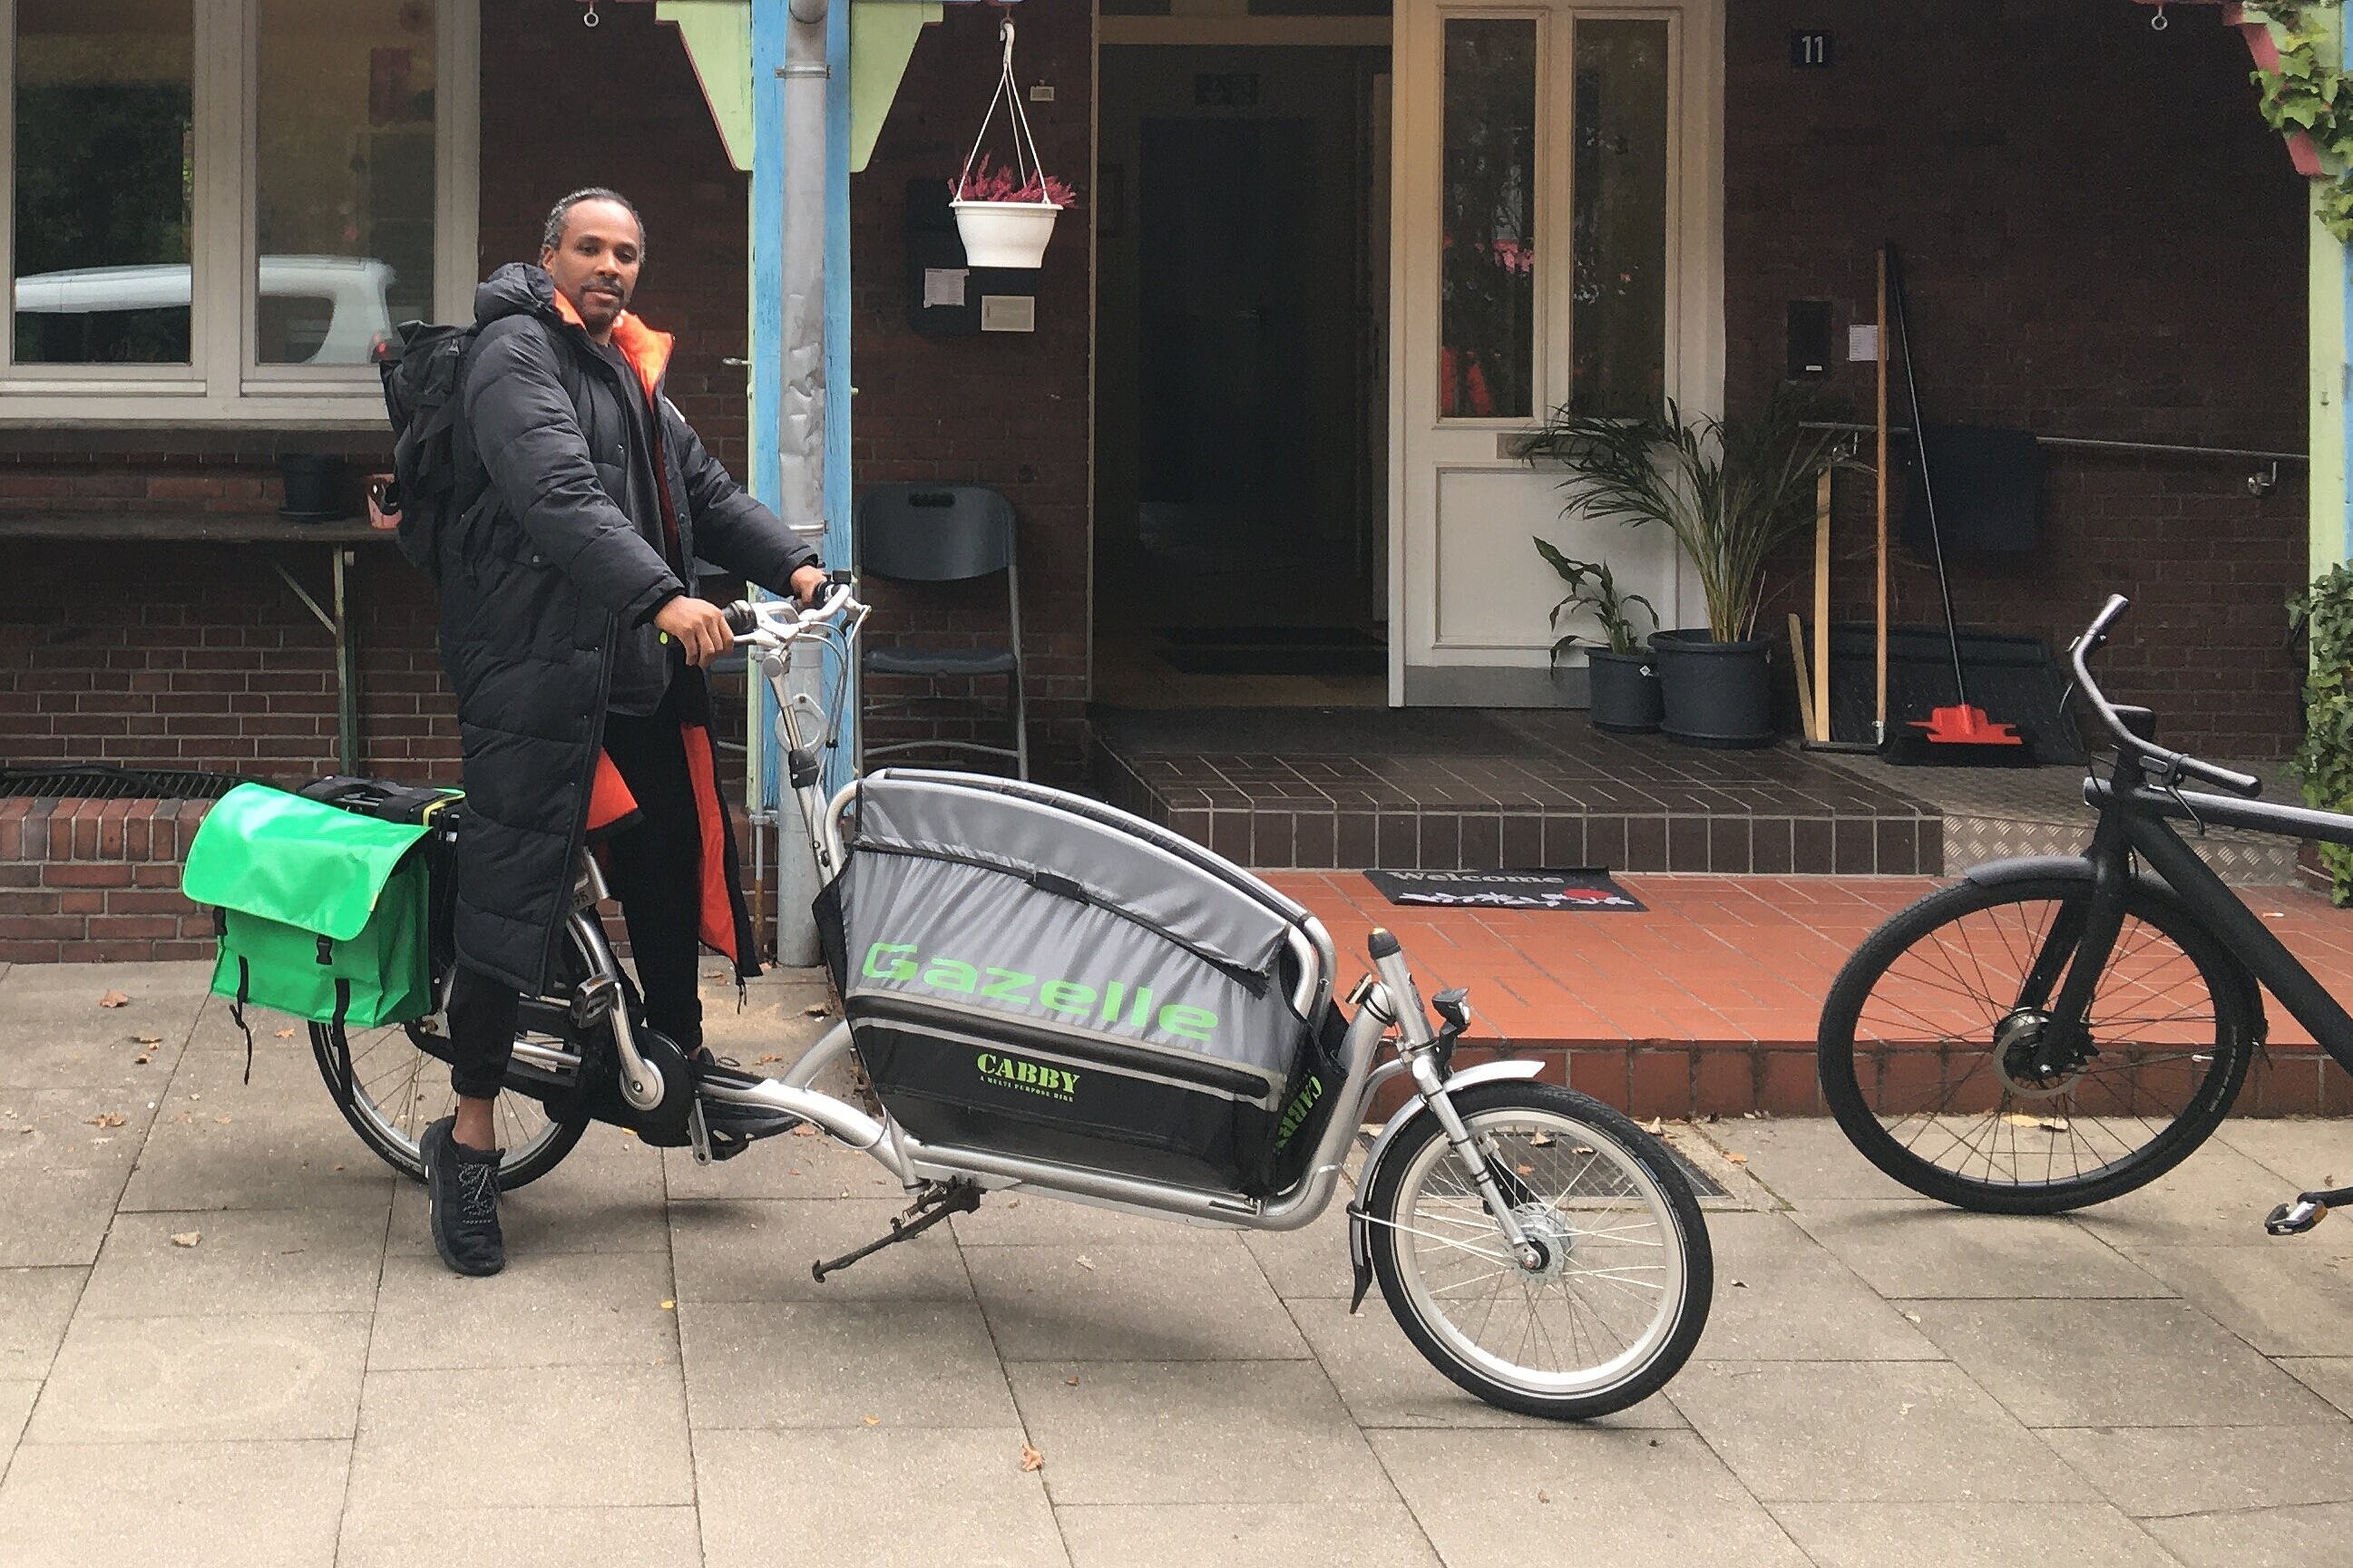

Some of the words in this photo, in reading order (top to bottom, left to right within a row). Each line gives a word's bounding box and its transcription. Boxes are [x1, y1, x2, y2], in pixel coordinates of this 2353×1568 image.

[1801, 35, 1823, 63] 11
[1387, 872, 1564, 884] Welcome
[863, 941, 1218, 1042] Gazelle
[978, 1054, 1080, 1094] CABBY
[987, 1077, 1012, 1088] MULTI
